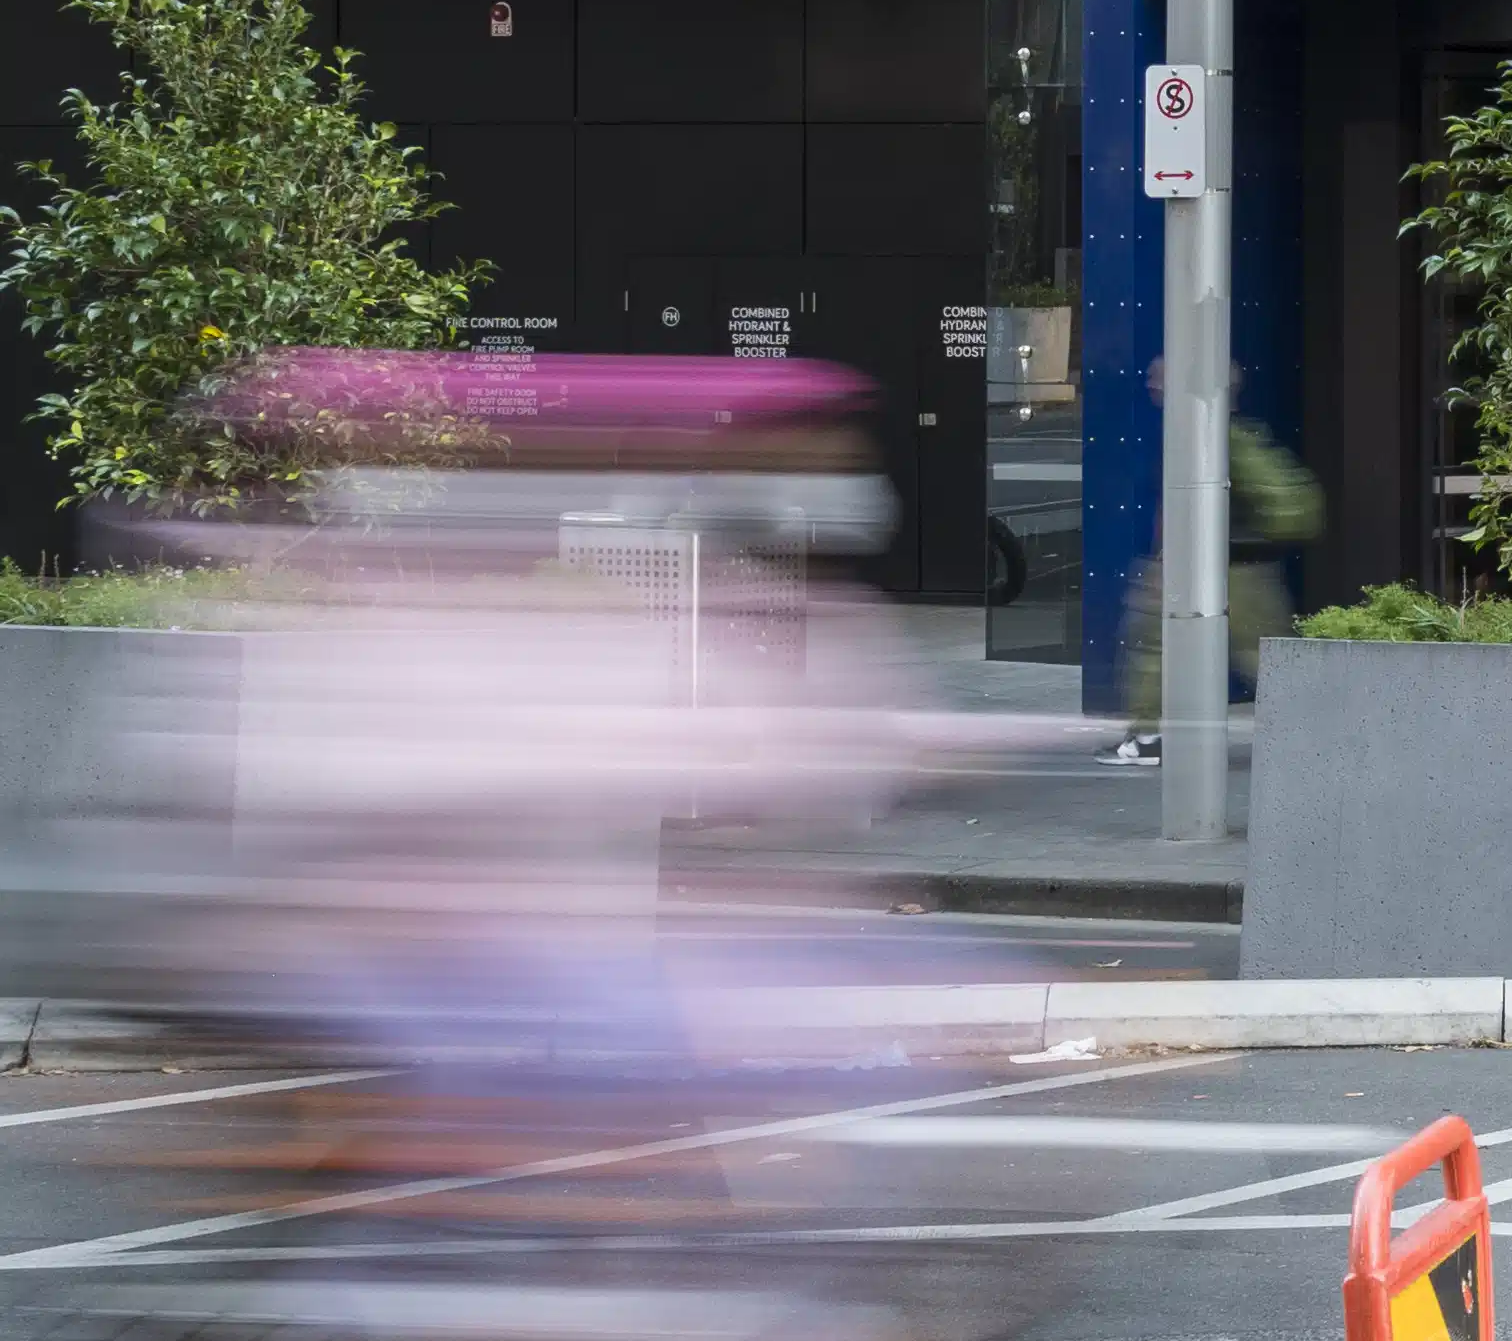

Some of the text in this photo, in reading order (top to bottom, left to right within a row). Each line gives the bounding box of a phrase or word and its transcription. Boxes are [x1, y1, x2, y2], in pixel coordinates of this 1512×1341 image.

[731, 307, 790, 318] COMBINED
[446, 317, 558, 329] FIRE CONTROL ROOM
[729, 321, 791, 331] HYDRANT &
[513, 336, 524, 344] TO
[732, 334, 790, 345] SPRINKLER
[735, 347, 787, 357] BOOSTER
